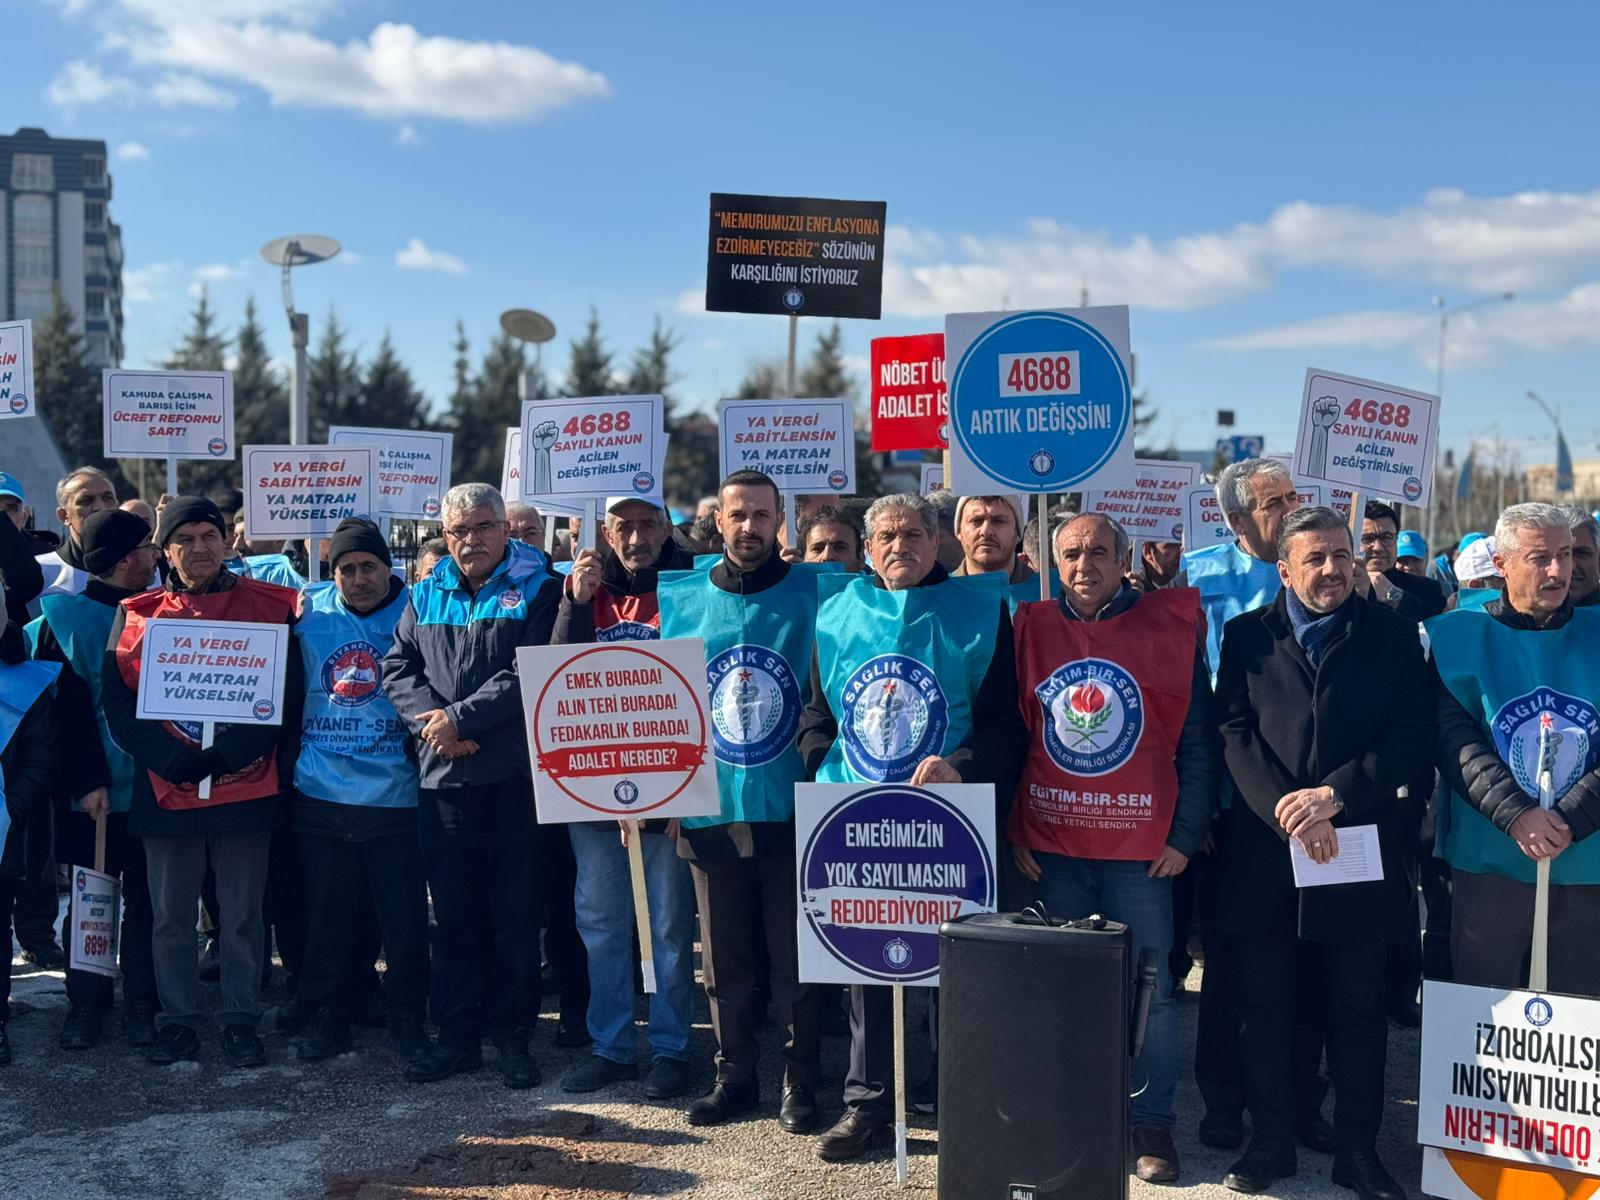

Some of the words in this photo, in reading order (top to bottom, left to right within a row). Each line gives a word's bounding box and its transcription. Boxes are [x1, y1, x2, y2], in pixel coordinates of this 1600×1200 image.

[806, 216, 880, 236] ENFLASYONA
[822, 240, 876, 261] SÖZÜNÜN
[731, 263, 797, 284] KARŞILIĞINI
[800, 265, 858, 286] İSTİYORUZ
[881, 359, 928, 387] NÖBET
[1007, 356, 1071, 392] 4688
[121, 391, 165, 399] KAMUDA
[168, 392, 213, 400] ÇALIŞMA
[139, 402, 172, 410] BARIŞI
[175, 402, 196, 410] İÇİN
[878, 394, 933, 419] ADALET
[1344, 398, 1411, 428] 4688
[113, 410, 157, 423] ÜCRET
[158, 413, 222, 424] REFORMU
[563, 410, 631, 436] 4688
[747, 416, 766, 428] YA
[772, 413, 819, 426] VERGİ
[970, 405, 1022, 435] ARTIK
[1027, 400, 1111, 436] DEĞİŞSİN!
[148, 426, 187, 437] ŞART!
[734, 428, 837, 443] SABİTLENSİN
[1332, 423, 1373, 439] SAYILI
[1374, 429, 1418, 445] KANUN
[553, 440, 593, 452] SAYILI
[596, 433, 643, 448] KANUN
[1355, 443, 1395, 457] ACİLEN
[388, 450, 431, 460] ÇALIŞMA
[578, 450, 619, 463] ACİLEN
[741, 450, 760, 461] YA
[765, 447, 831, 460] MATRAH
[273, 462, 292, 473] YA
[299, 459, 346, 472] VERGİ
[394, 461, 414, 470] İÇİN
[557, 463, 641, 480] DEĞİŞTİRİLSİN!
[1332, 456, 1414, 476] DEĞİŞTİRİLSİN!
[259, 475, 362, 489] SABİTLENSİN
[379, 472, 438, 485] REFORMU
[266, 494, 286, 505] YA
[291, 493, 357, 504] MATRAH
[1103, 490, 1177, 502] YANSITILSIN
[269, 506, 354, 520] YÜKSELSİN
[1095, 502, 1141, 513] EMEKLİ
[1142, 505, 1182, 516] NEFES
[1119, 517, 1158, 528] ALSIN!
[173, 636, 192, 648] YA
[200, 638, 250, 651] VERGİ
[157, 652, 267, 669] SABİTLENSİN
[162, 671, 182, 683] YA
[188, 672, 259, 686] MATRAH
[565, 671, 601, 690] EMEK
[606, 668, 662, 688] BURADA!
[764, 657, 791, 689] SEN
[845, 662, 903, 703] SAĞLIK
[909, 669, 940, 703] SEN
[164, 685, 256, 703] YÜKSELSİN
[557, 699, 586, 717] ALIN
[588, 694, 618, 715] TERİ
[621, 694, 677, 712] BURADA!
[304, 714, 362, 732] DİYANET
[1500, 694, 1556, 734] SAĞLIK
[1564, 704, 1600, 735] SEN
[330, 733, 364, 743] DİYANET
[551, 722, 630, 743] FEDAKARLIK
[633, 719, 689, 738] BURADA!
[1106, 722, 1136, 762] SENDİKASI
[569, 751, 616, 771] ADALET
[620, 748, 678, 768] NEREDE?
[1106, 807, 1151, 816] SENDİKASI
[1040, 813, 1062, 824] ENEL
[1064, 817, 1096, 828] YETKİLİ
[1098, 819, 1137, 829] SENDİKA
[845, 819, 944, 848] EMEĞİMİZİN
[824, 862, 857, 886] YOK
[861, 863, 966, 888] SAYILMASINI
[831, 895, 962, 925] REDDEDİYORUZ
[1445, 1104, 1591, 1167] ÖDEMELERİN
